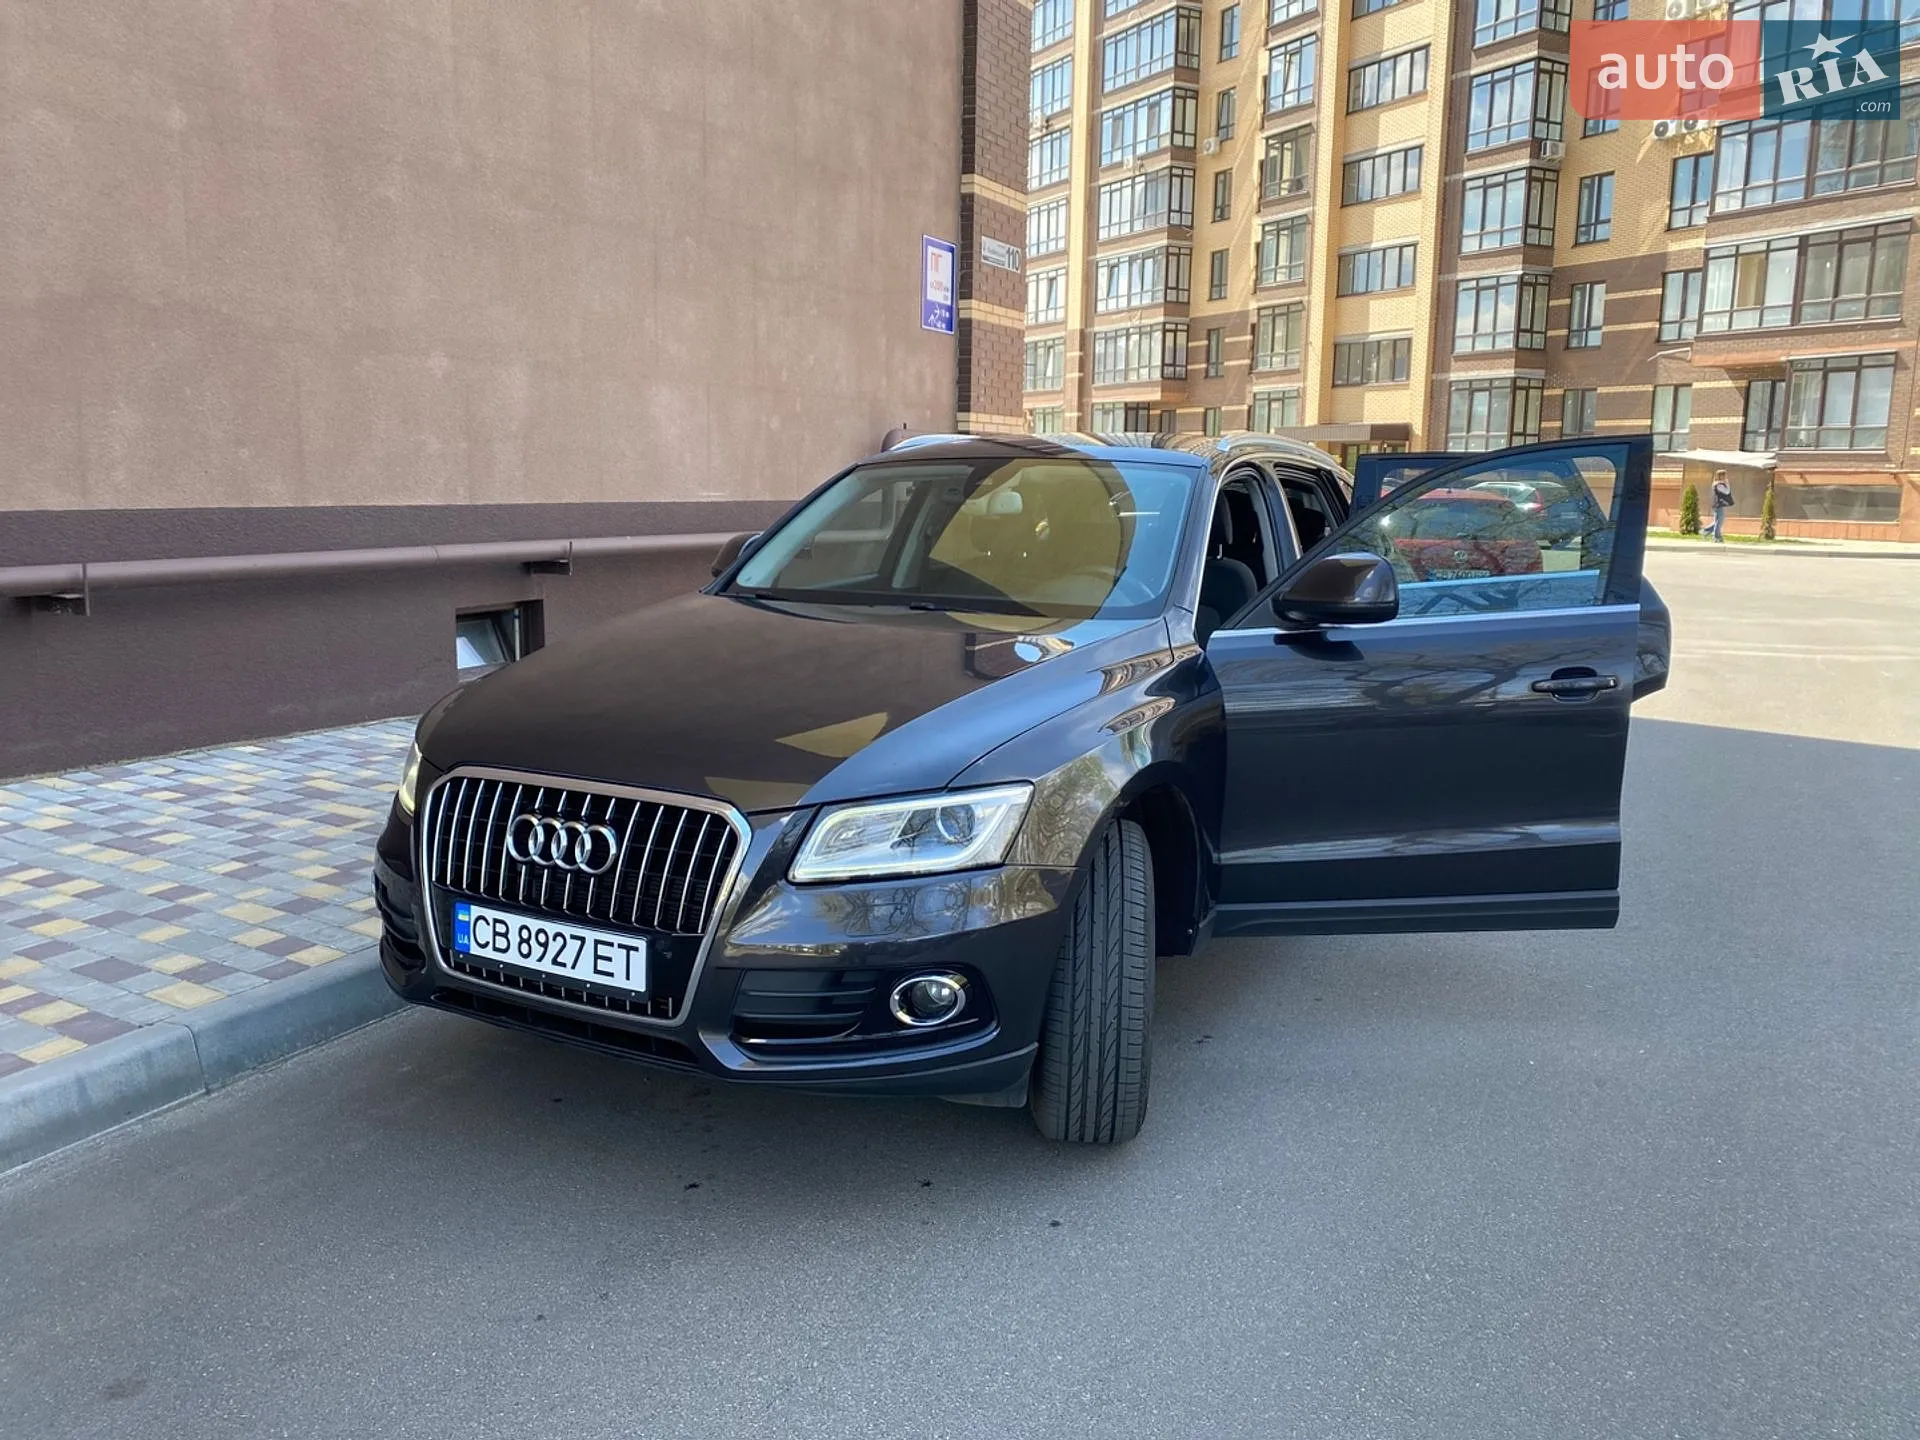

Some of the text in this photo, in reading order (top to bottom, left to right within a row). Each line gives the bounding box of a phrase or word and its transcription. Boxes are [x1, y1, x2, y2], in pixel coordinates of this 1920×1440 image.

[457, 933, 470, 945] UA
[472, 915, 640, 981] CB 8927 ET
